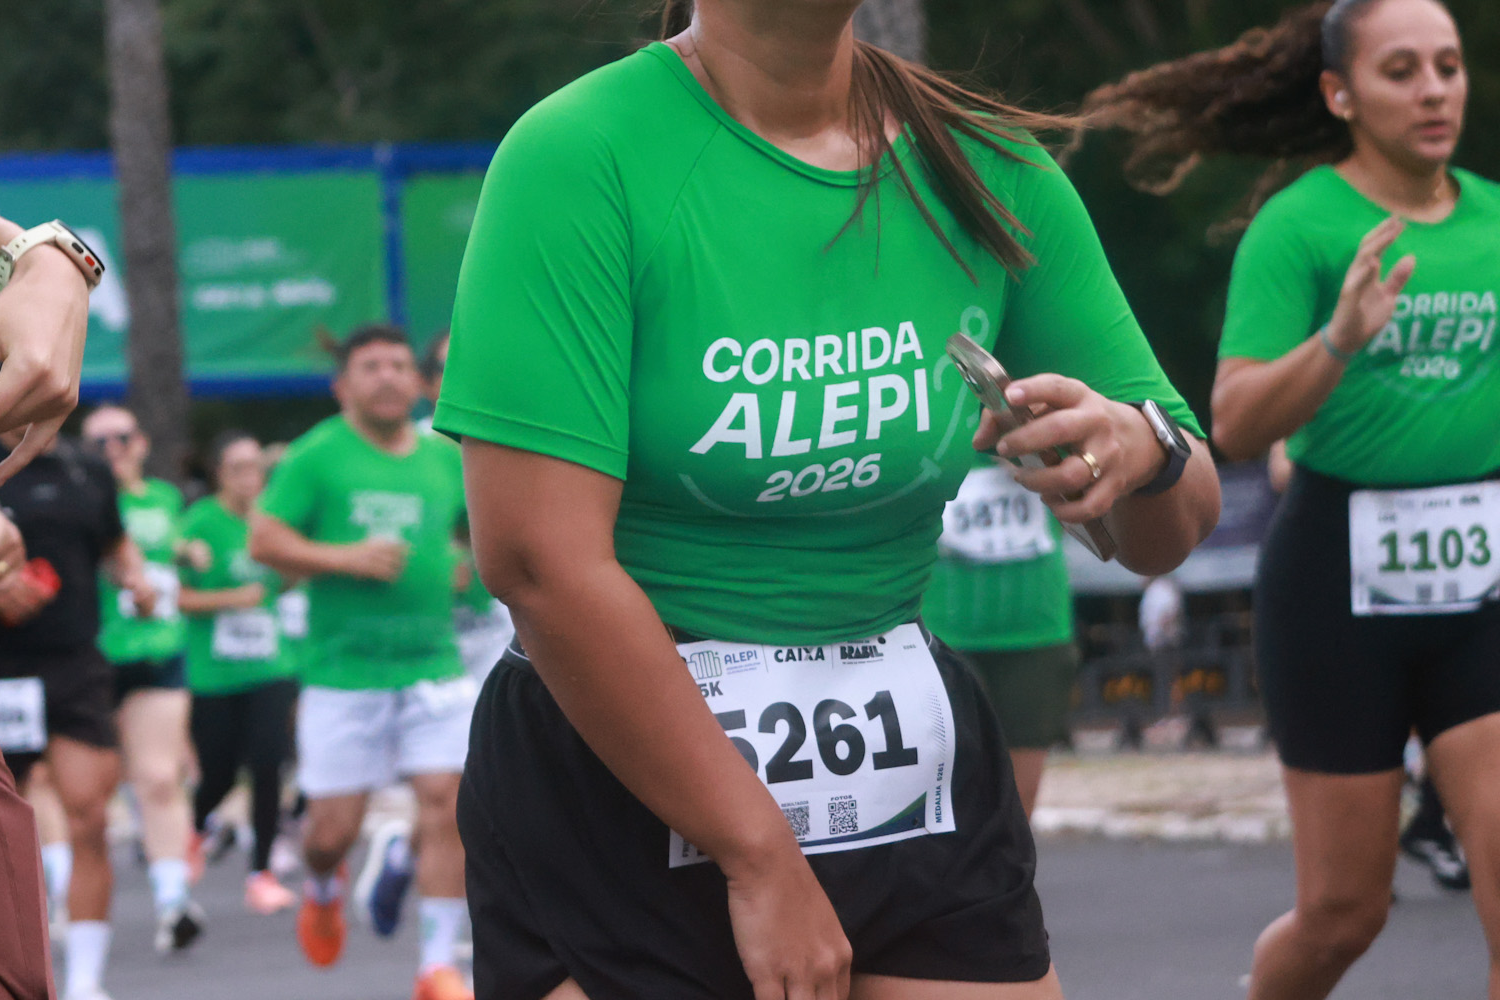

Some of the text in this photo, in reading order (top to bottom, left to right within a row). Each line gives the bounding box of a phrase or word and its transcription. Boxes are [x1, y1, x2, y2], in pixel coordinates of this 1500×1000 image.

[1393, 291, 1496, 319] ORRIDA
[1366, 318, 1496, 356] ALEPI
[702, 321, 924, 385] CORRIDA
[1400, 355, 1460, 380] 2026
[689, 368, 930, 460] ALEPI
[757, 453, 881, 502] 2026
[1379, 523, 1491, 572] 1103
[724, 650, 758, 665] ALEPI
[773, 647, 825, 663] CAIXA
[840, 645, 884, 660] BRASIL
[936, 762, 945, 782] 5261
